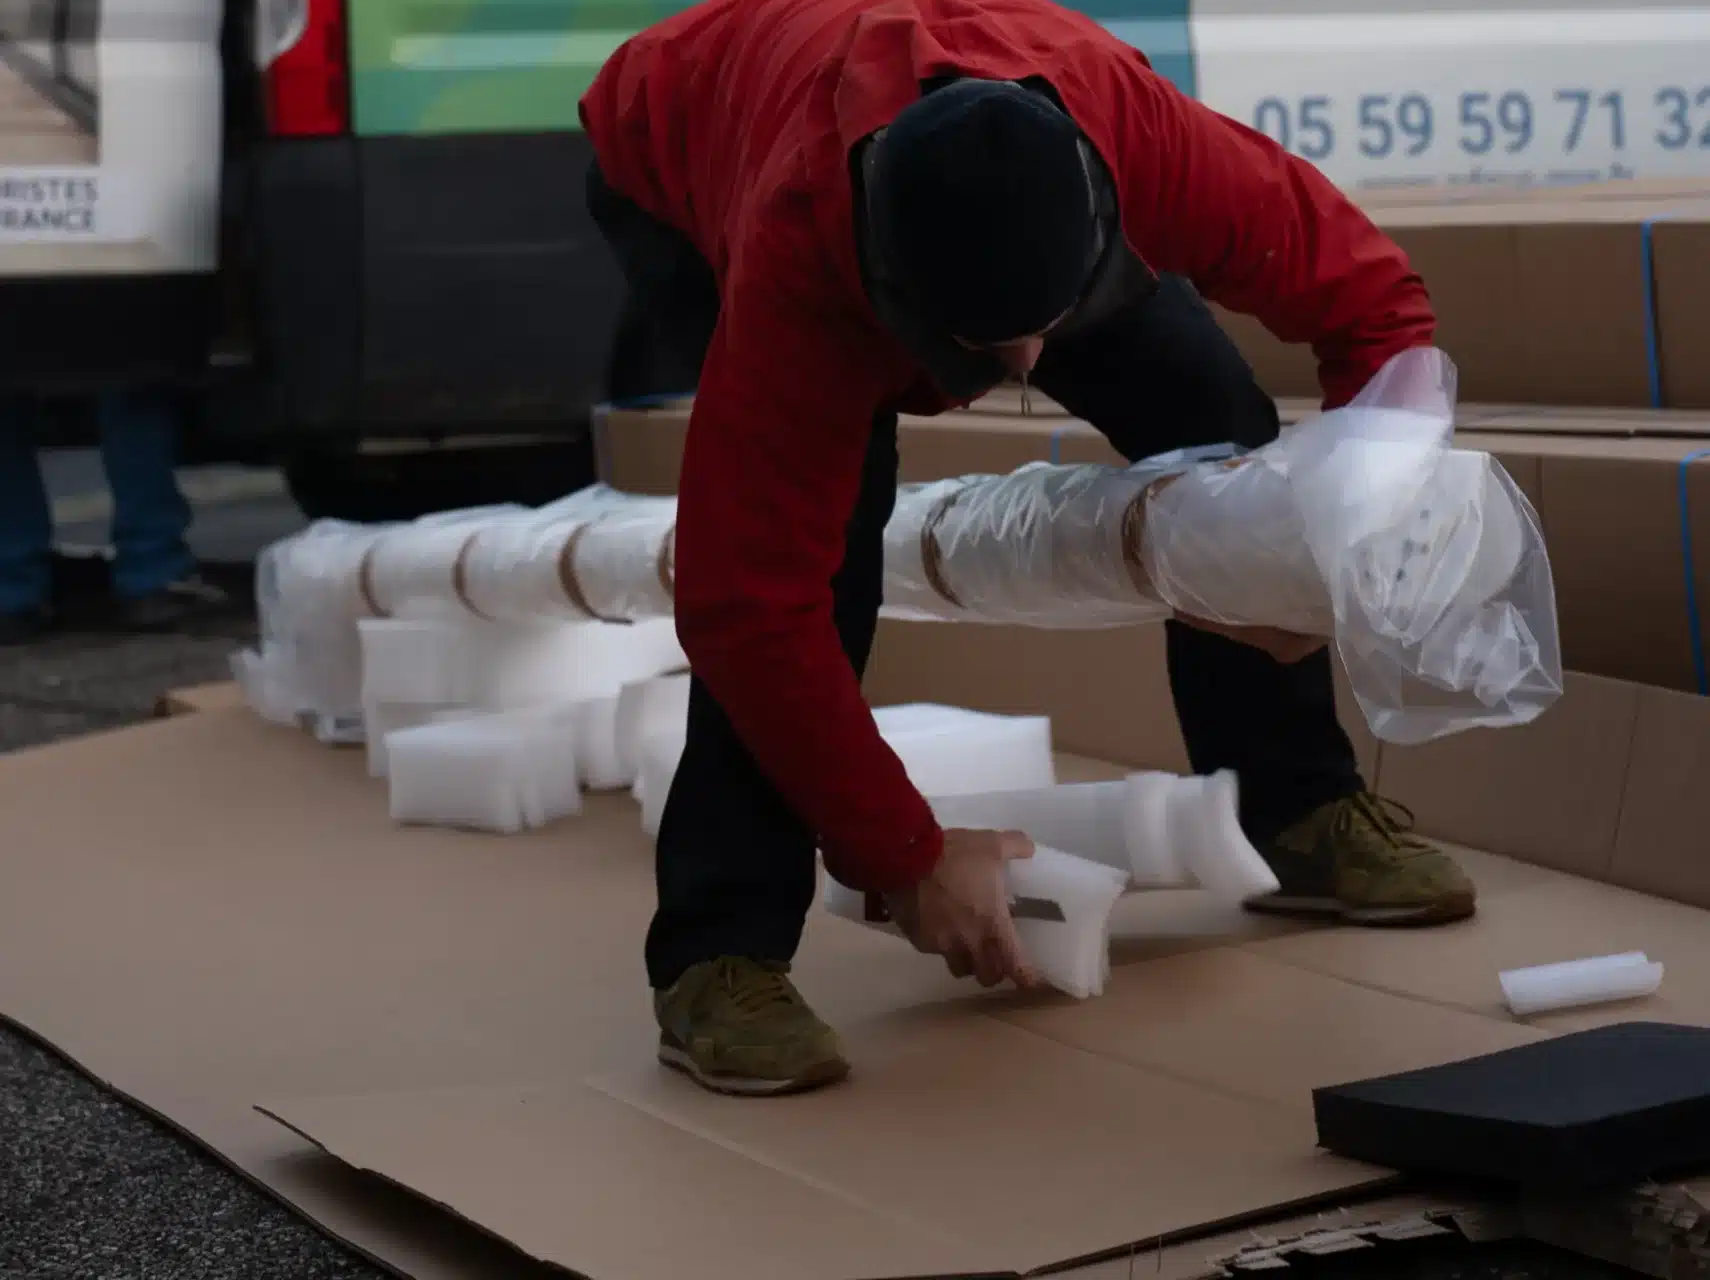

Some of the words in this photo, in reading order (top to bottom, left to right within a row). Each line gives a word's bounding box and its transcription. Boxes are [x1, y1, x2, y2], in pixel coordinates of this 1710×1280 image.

[1254, 94, 1336, 160] 05
[1357, 92, 1434, 158] 59
[1458, 90, 1535, 155] 59
[1555, 87, 1626, 153] 71
[0, 177, 98, 202] RISTES
[0, 206, 96, 233] RANCE
